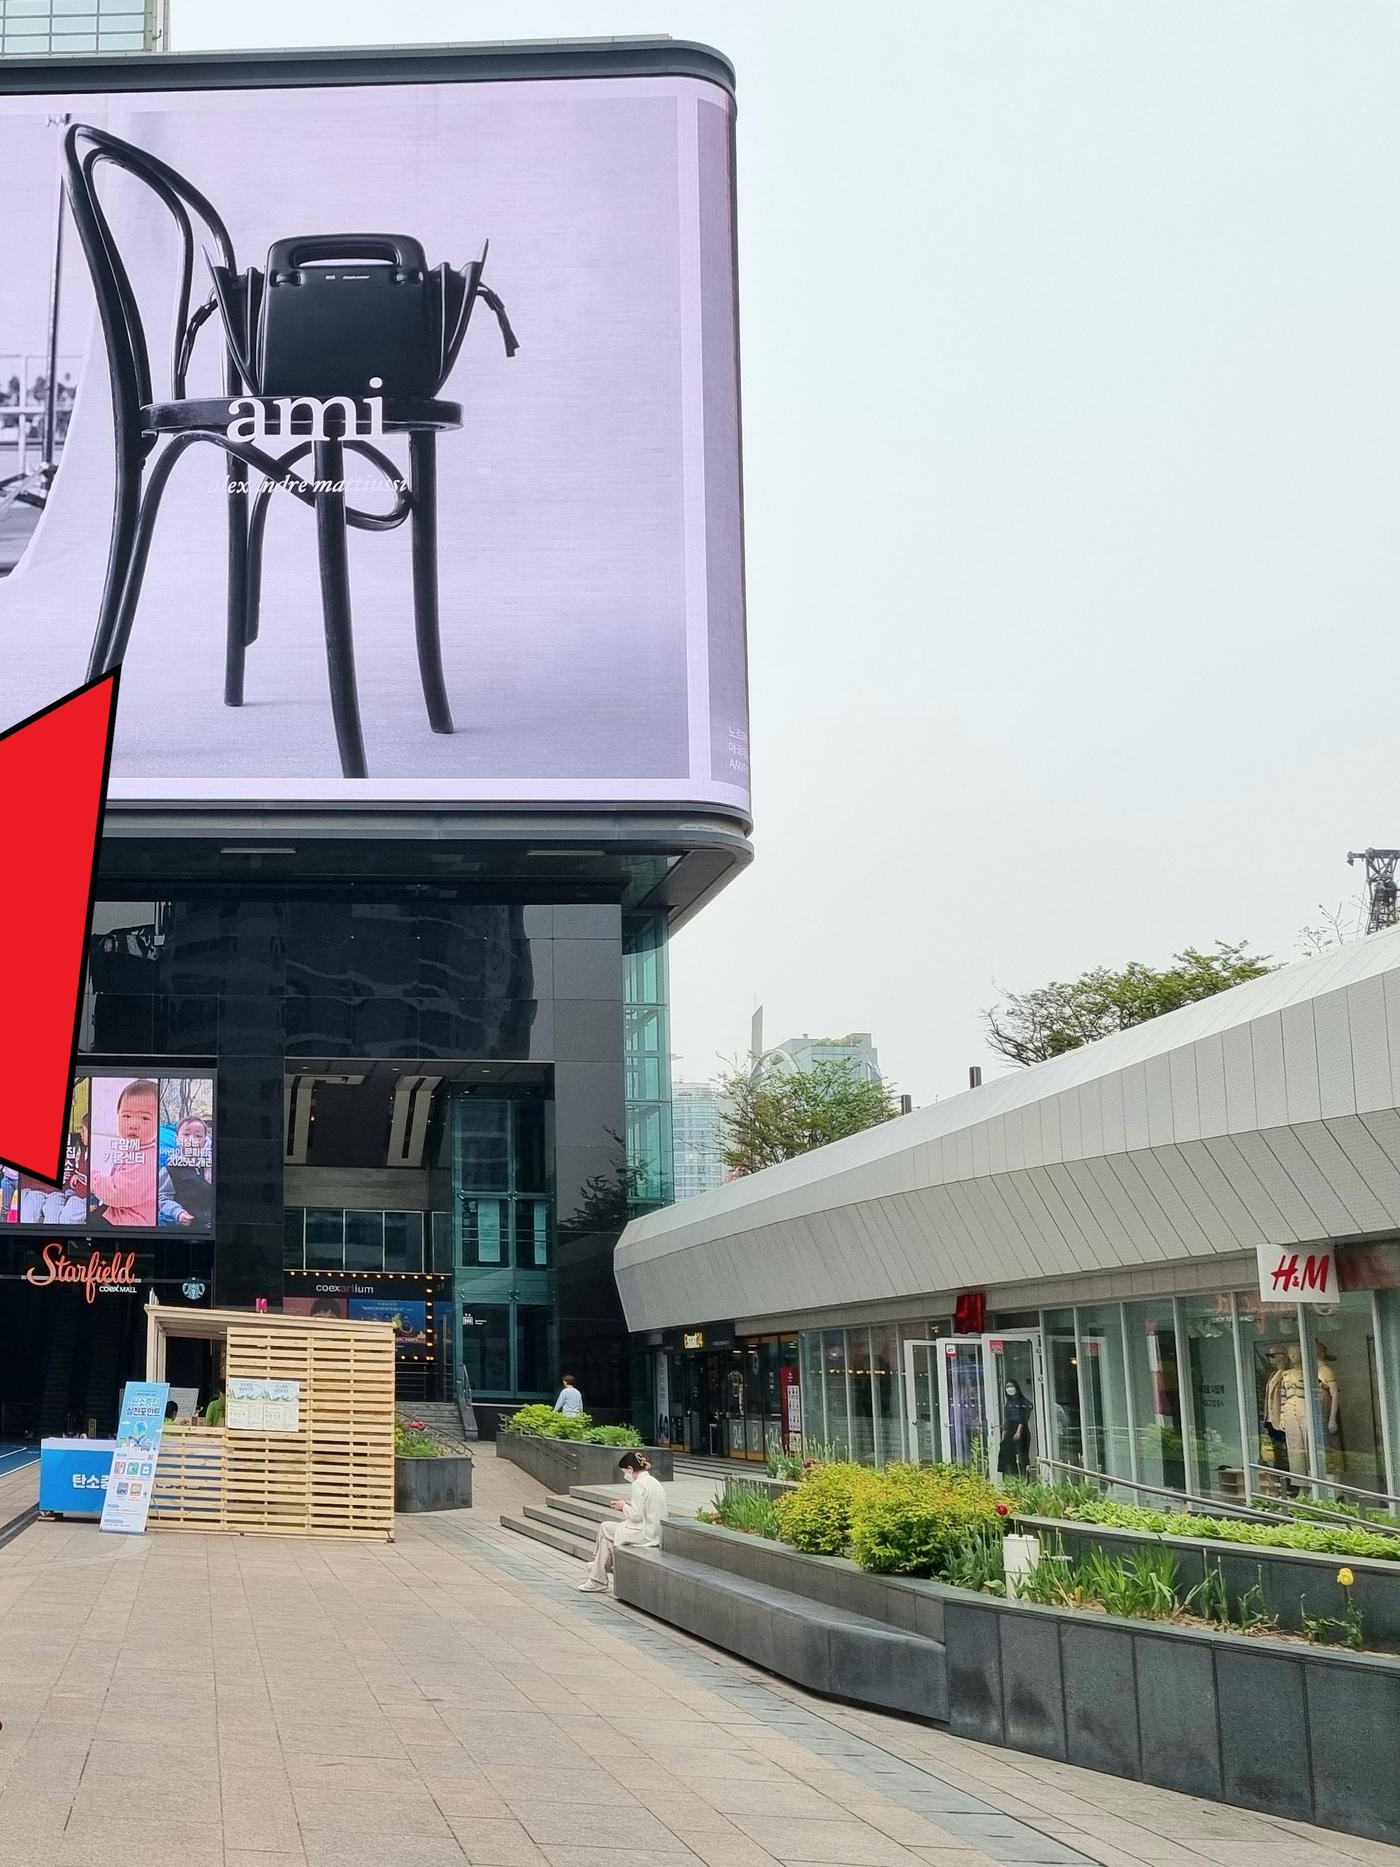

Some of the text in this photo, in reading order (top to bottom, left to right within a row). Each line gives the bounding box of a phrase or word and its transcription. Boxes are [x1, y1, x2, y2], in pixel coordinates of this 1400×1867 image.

[226, 377, 384, 443] ami
[208, 475, 308, 494] alexandre
[26, 1243, 135, 1303] Starfield
[1270, 1254, 1330, 1293] H&M
